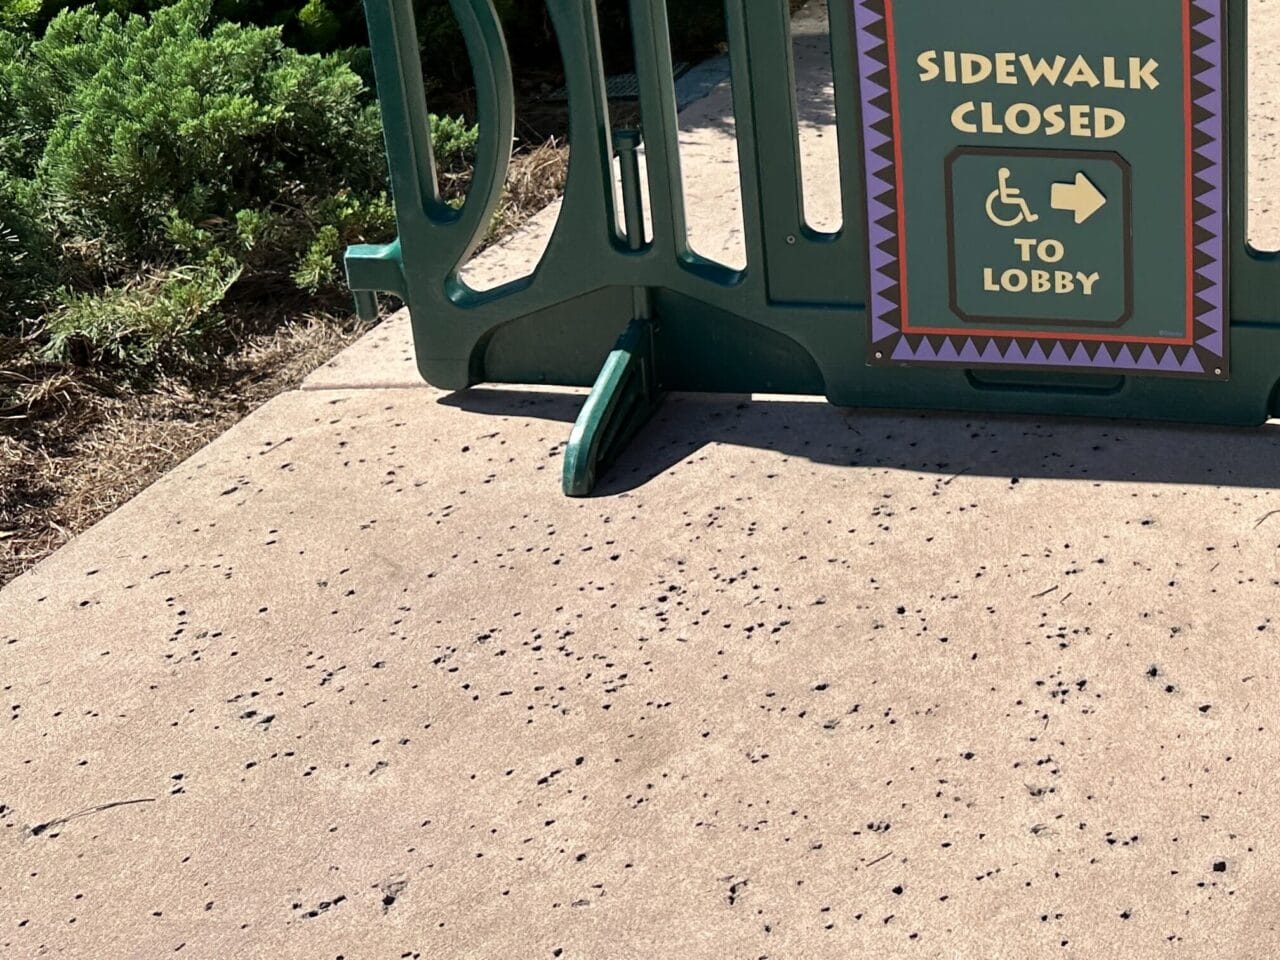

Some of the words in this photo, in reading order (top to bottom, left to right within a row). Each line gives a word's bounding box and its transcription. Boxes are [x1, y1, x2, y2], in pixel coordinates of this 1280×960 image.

[916, 50, 1160, 90] SIDEWALK
[950, 101, 1126, 138] CLOSED
[1014, 238, 1065, 263] TO
[983, 267, 1100, 295] LOBBY
